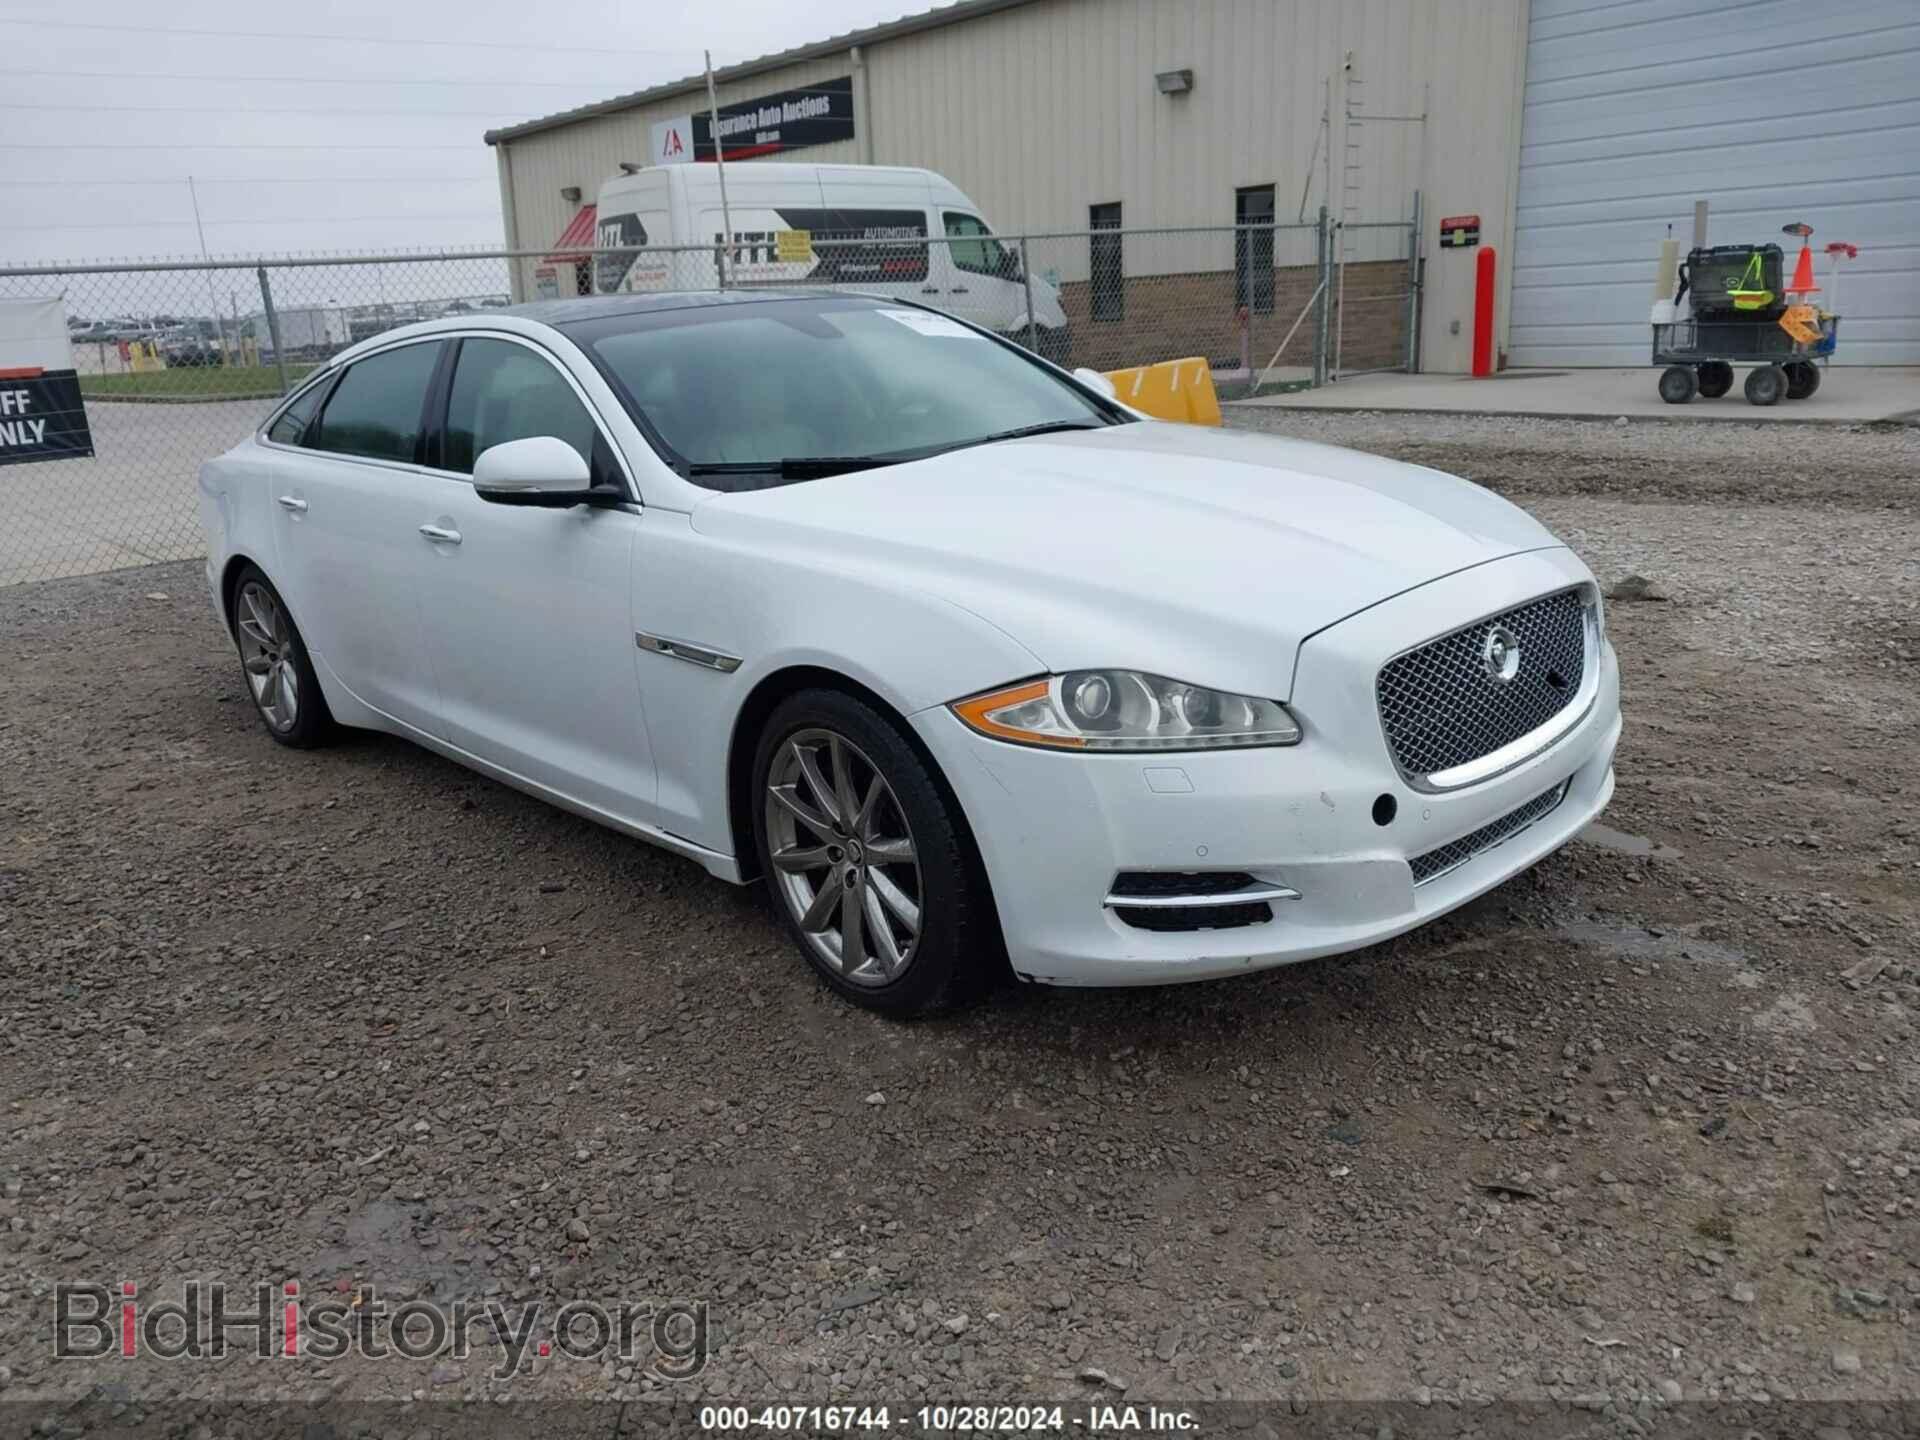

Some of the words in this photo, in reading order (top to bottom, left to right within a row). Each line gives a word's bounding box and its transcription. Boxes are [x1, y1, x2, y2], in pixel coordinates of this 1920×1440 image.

[709, 112, 757, 138] Isurance
[758, 106, 781, 128] Auto
[783, 95, 830, 122] Auctions
[863, 226, 920, 240] AUTOMOTIVE
[0, 390, 31, 415] FF
